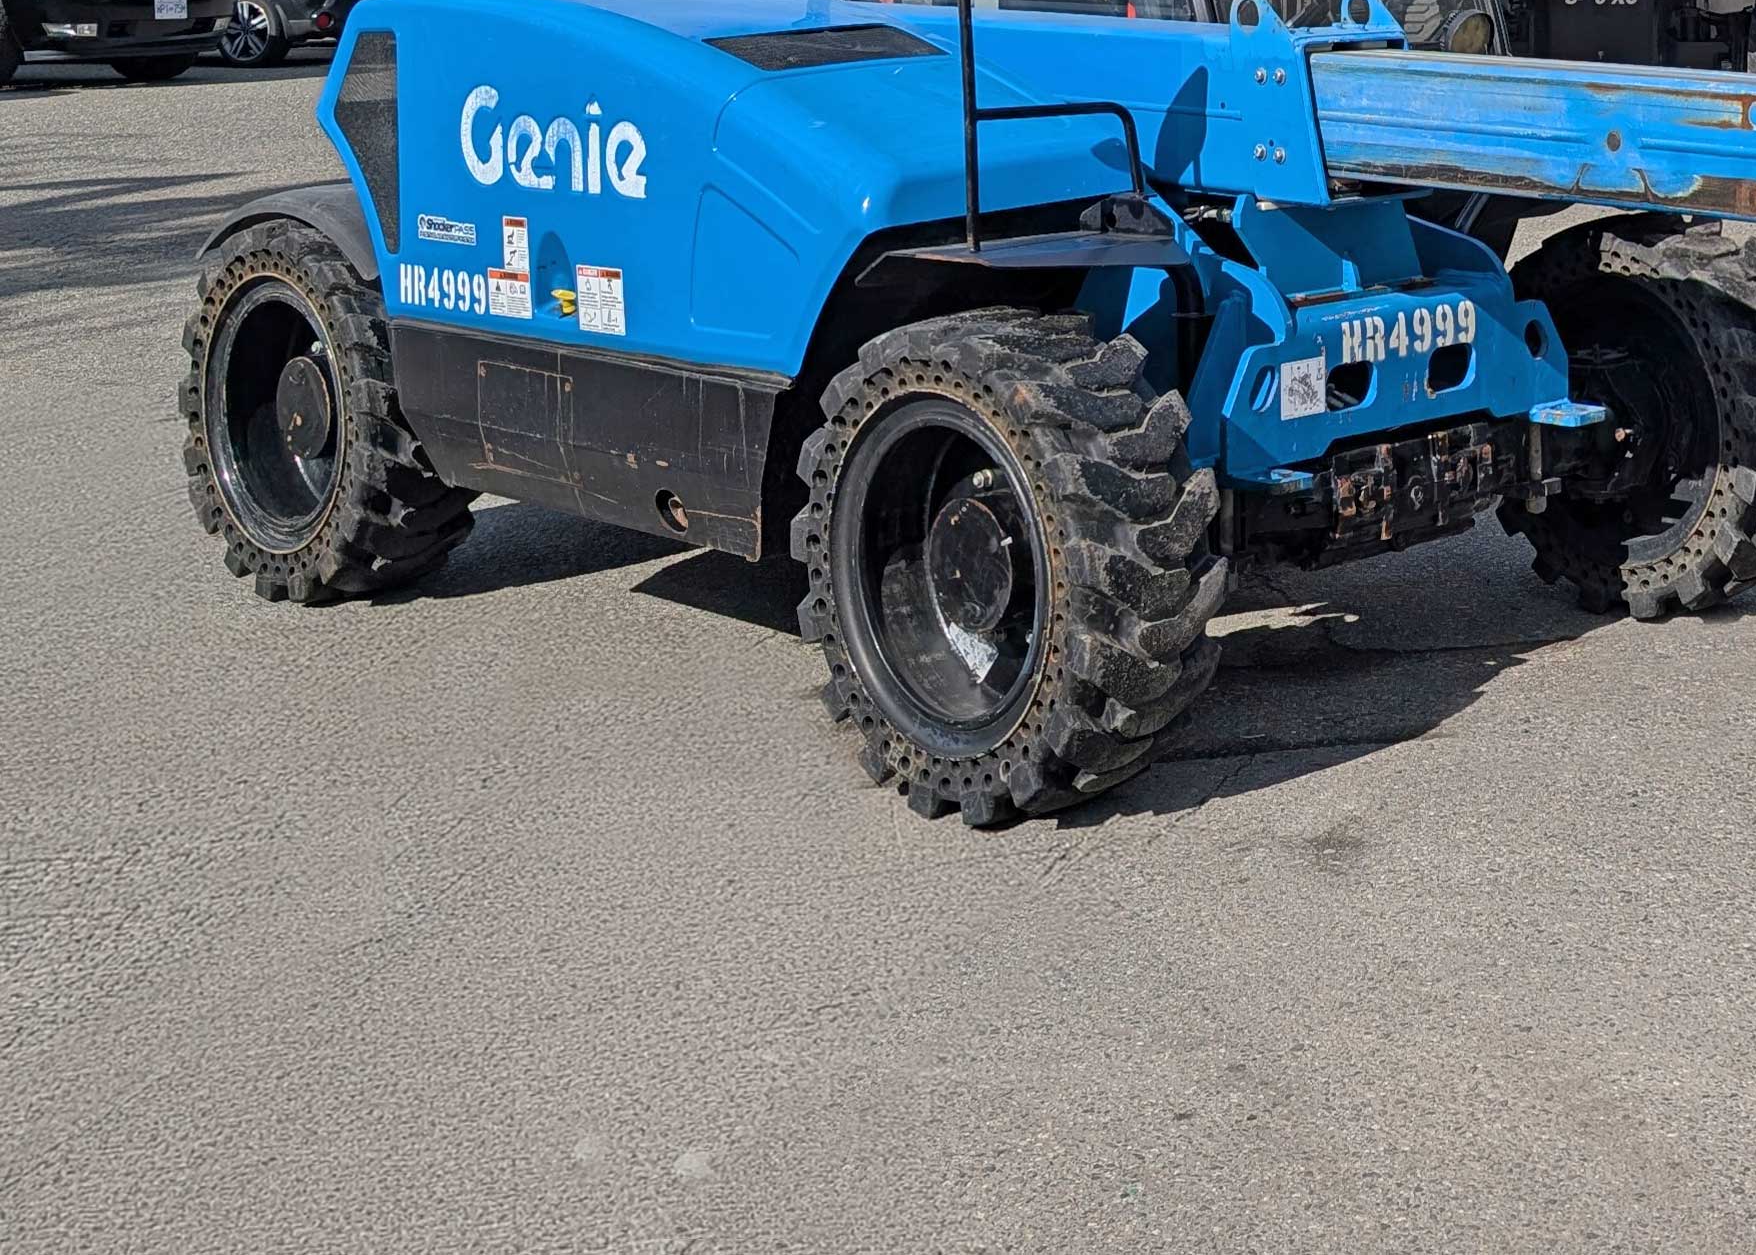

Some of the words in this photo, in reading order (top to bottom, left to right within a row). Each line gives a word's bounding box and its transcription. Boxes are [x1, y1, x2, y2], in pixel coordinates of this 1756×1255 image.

[460, 85, 647, 199] Genie
[400, 262, 487, 315] HR4999
[1341, 299, 1476, 364] HR4999
